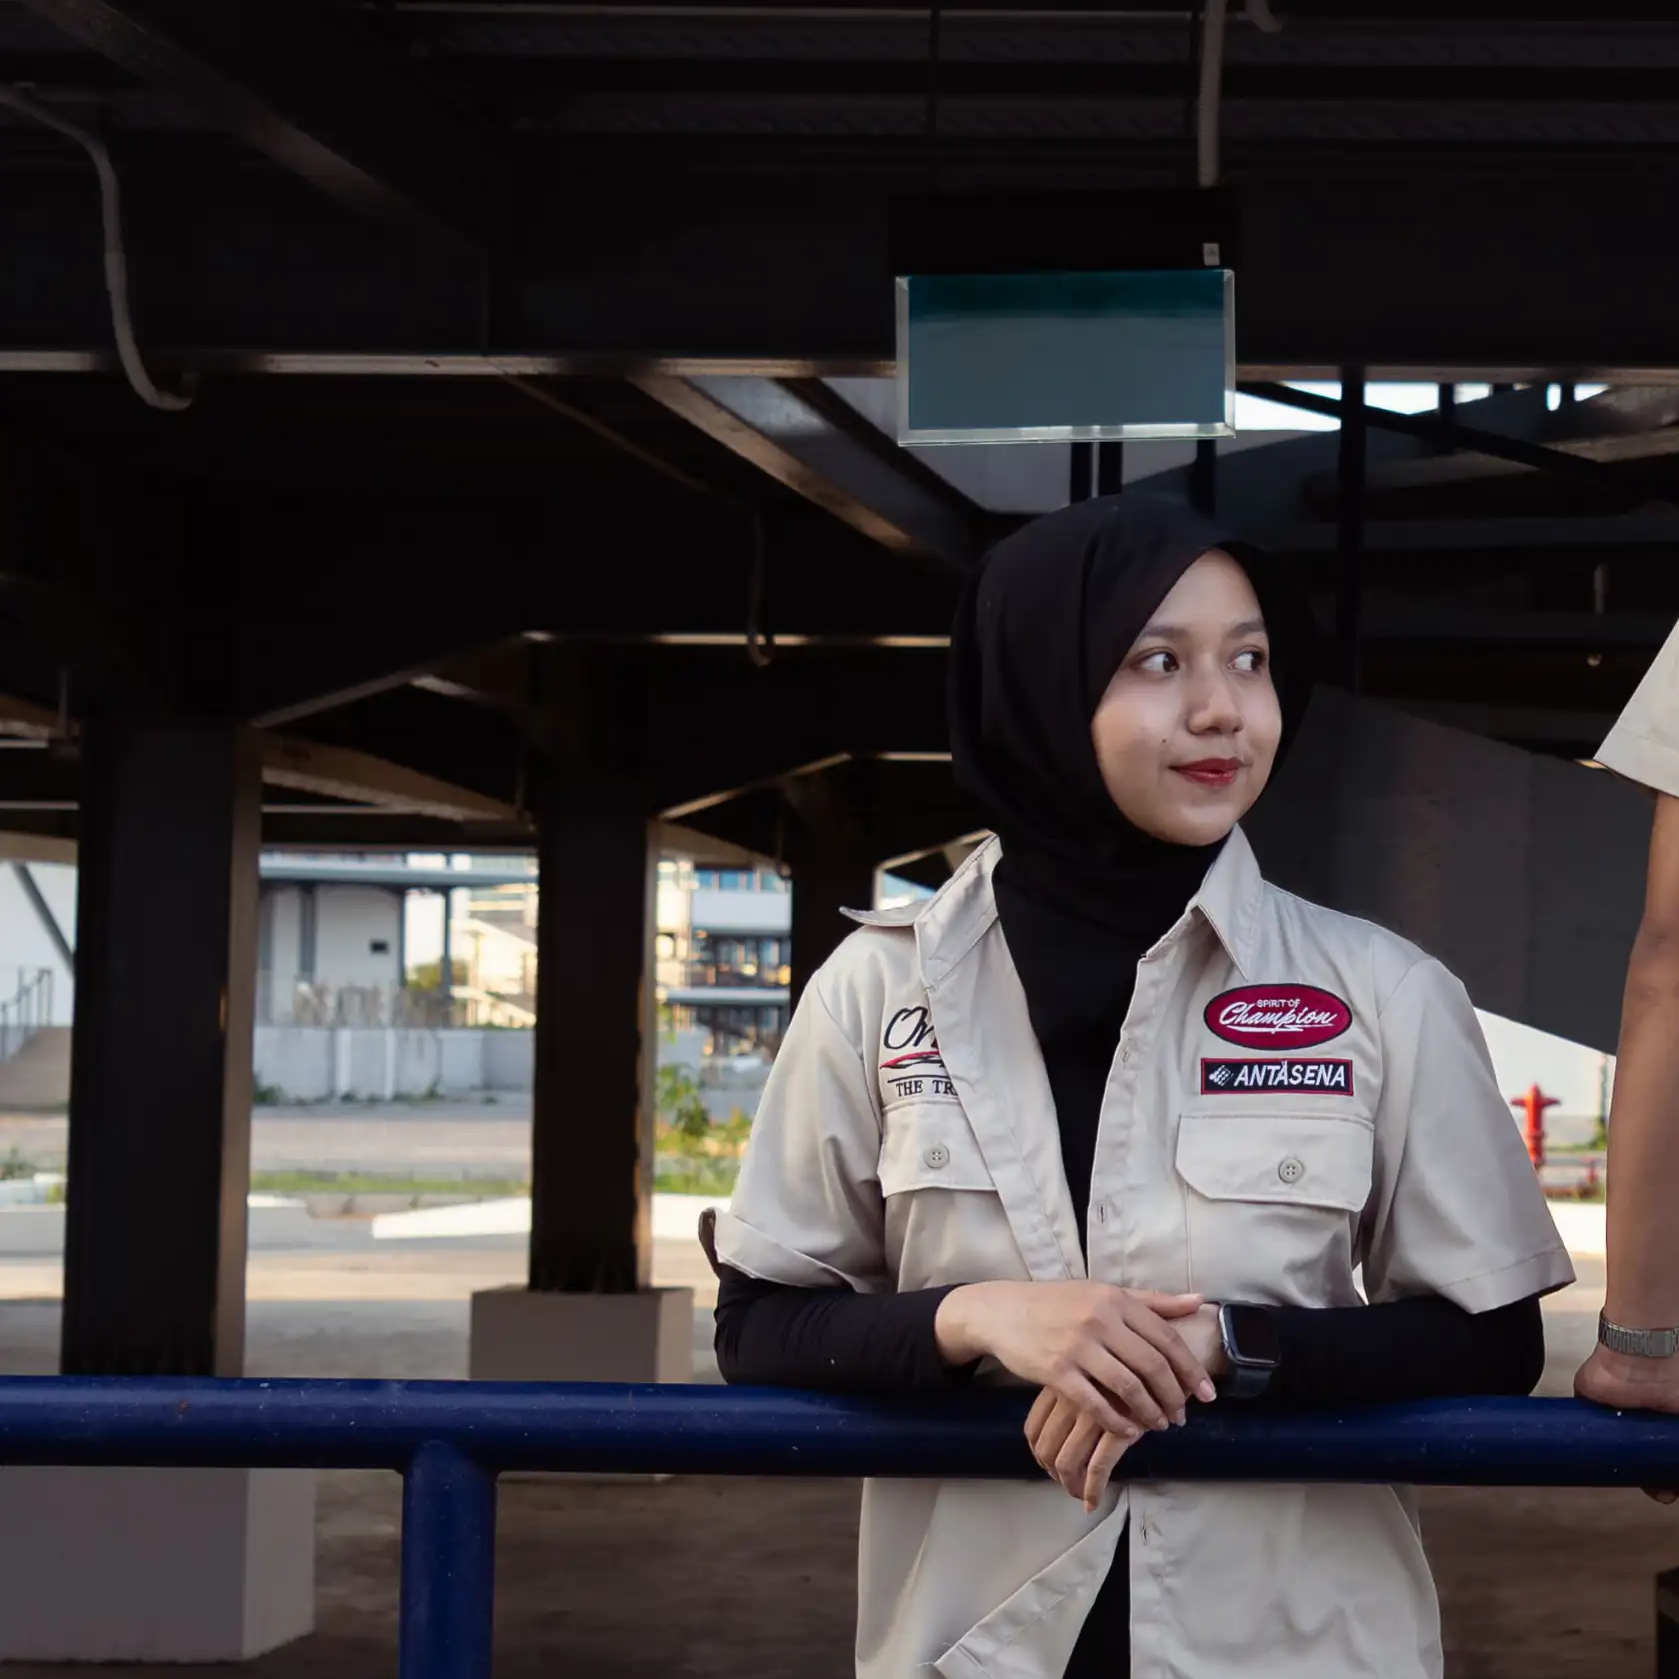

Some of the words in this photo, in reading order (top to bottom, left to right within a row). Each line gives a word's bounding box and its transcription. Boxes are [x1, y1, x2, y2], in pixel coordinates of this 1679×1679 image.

[1256, 998, 1287, 1009] SPIRIT
[1287, 998, 1301, 1009] OF
[1219, 1001, 1338, 1034] Champion
[1233, 1059, 1346, 1087] ANTASENA
[896, 1080, 924, 1097] THE
[931, 1079, 959, 1096] TR
